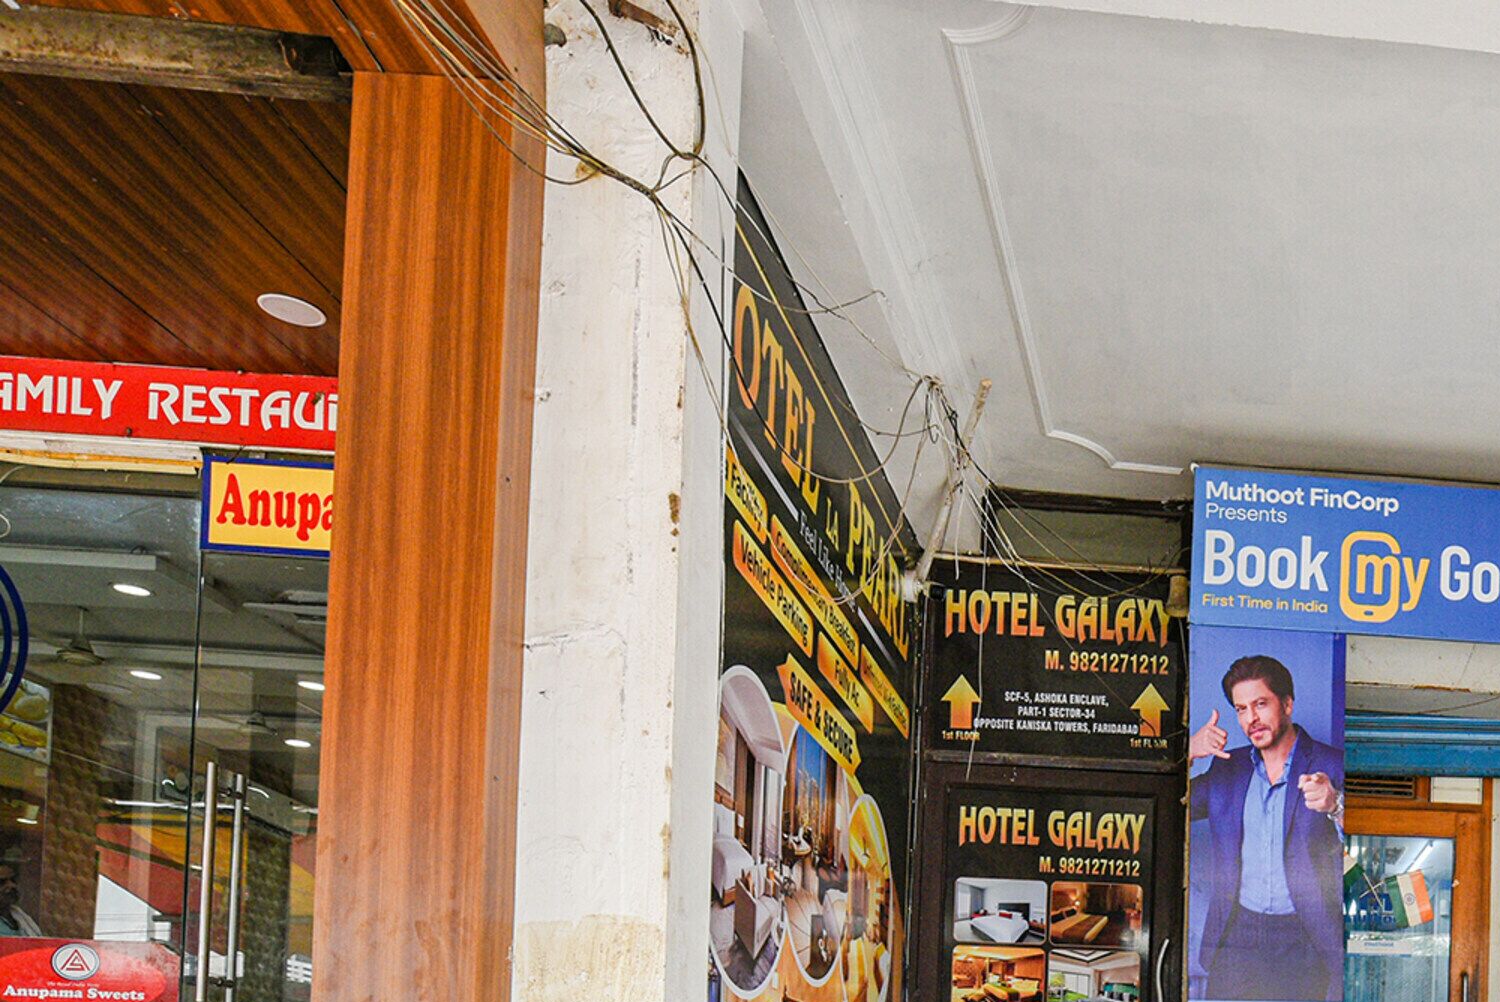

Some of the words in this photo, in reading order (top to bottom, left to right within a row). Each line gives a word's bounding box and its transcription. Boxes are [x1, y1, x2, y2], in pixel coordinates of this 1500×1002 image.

[733, 283, 820, 515] OTEL
[826, 496, 839, 552] LA
[846, 476, 909, 661] PEARL
[1205, 480, 1304, 505] Muthoot
[1310, 487, 1399, 516] FinCorp
[1205, 504, 1288, 524] Presents
[1203, 529, 1330, 593] Book
[1356, 553, 1430, 612] my
[740, 533, 775, 600] Vehicle
[777, 585, 809, 648] Parking
[1202, 593, 1234, 607] First
[1237, 594, 1273, 609] Time
[1276, 597, 1289, 610] in
[1292, 597, 1328, 613] India
[945, 588, 1045, 638] HOTEL
[1055, 594, 1171, 648] GALAXY
[1045, 650, 1064, 671] M.
[1070, 652, 1169, 675] 9821271212
[1034, 692, 1068, 704] ASHOKA
[790, 671, 813, 720] SAFE
[814, 700, 822, 731] &
[824, 709, 853, 765] SECURE
[1018, 706, 1047, 717] PART-1
[1049, 708, 1095, 719] SECTOR-34
[974, 718, 1015, 730] OPPOSITE
[1092, 723, 1138, 735] FARIDABAD
[959, 805, 1040, 847] HOTEL
[1047, 810, 1145, 854] GALAXY
[1039, 856, 1055, 873] M.
[1059, 857, 1140, 877] 9821271212
[3, 984, 83, 1000] Anupama
[87, 988, 145, 1001] Sweets
